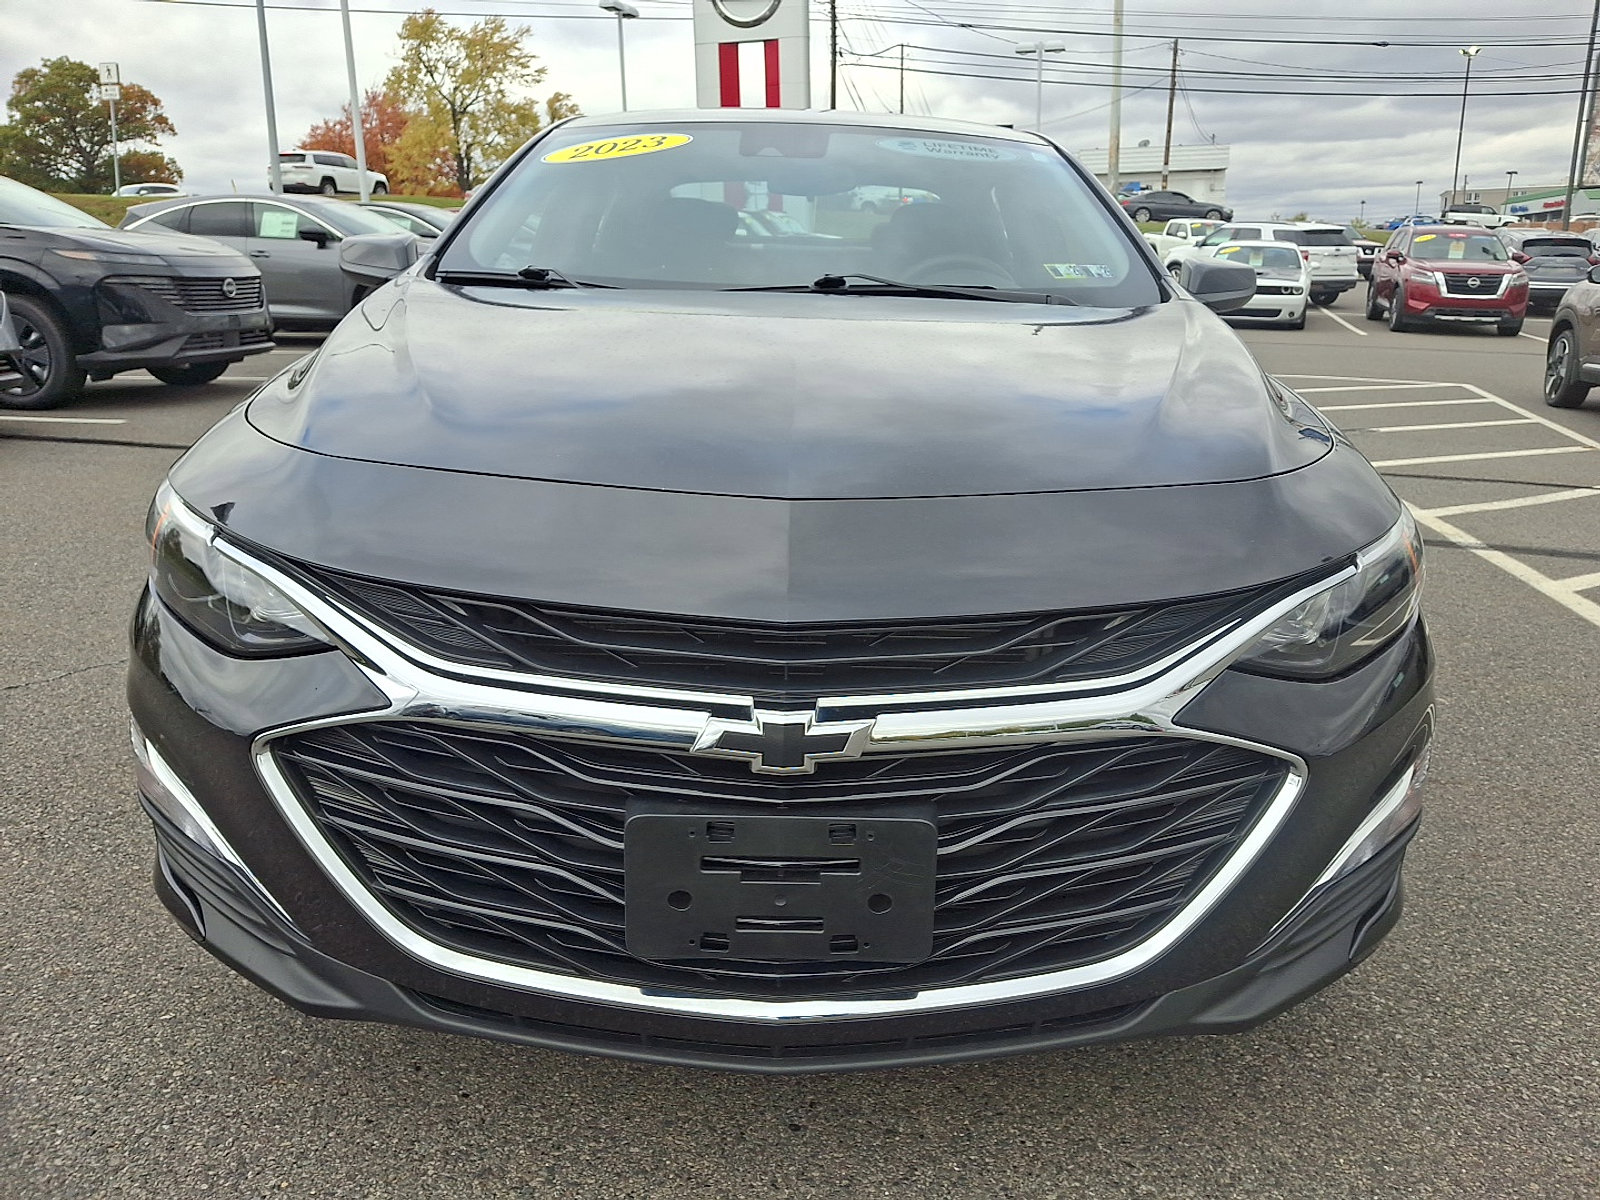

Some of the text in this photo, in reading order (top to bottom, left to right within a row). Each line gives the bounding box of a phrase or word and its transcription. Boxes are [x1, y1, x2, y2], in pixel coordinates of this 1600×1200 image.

[568, 136, 668, 159] 2023
[923, 142, 995, 153] LIFETIME
[926, 147, 1000, 159] Warranty
